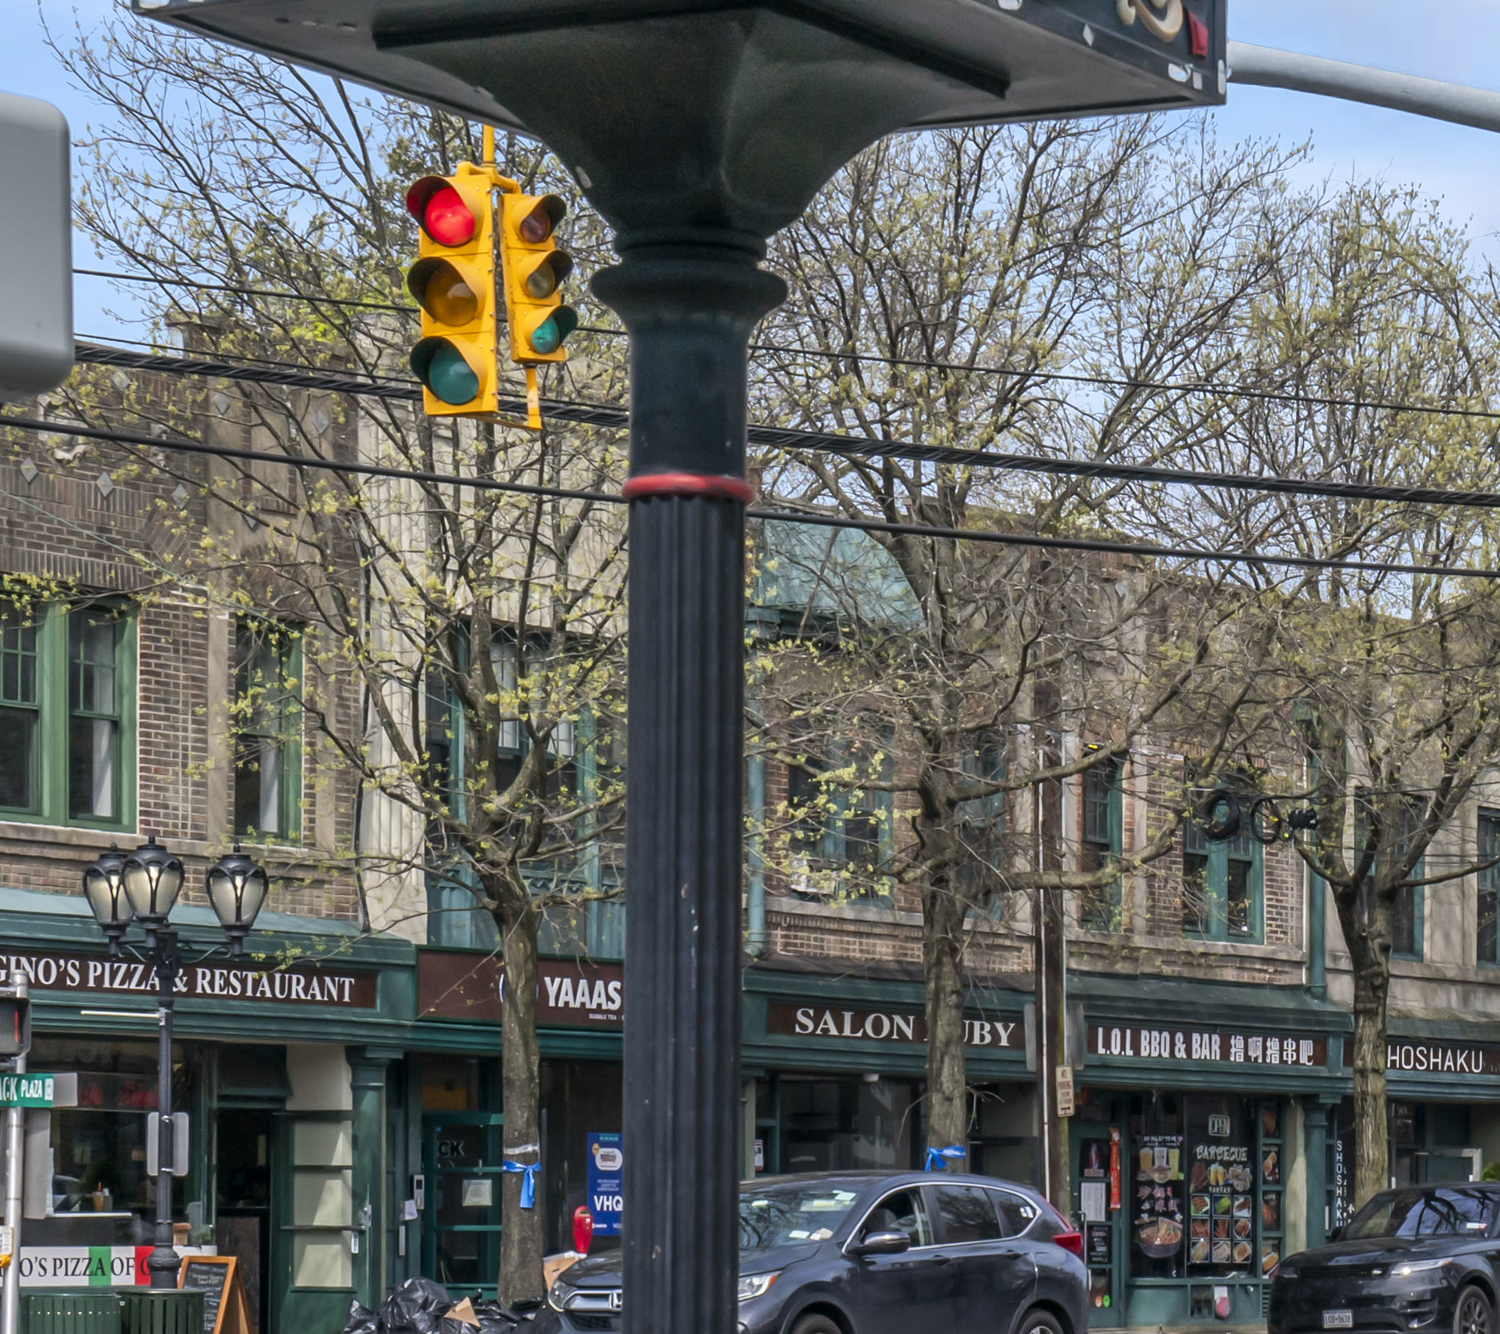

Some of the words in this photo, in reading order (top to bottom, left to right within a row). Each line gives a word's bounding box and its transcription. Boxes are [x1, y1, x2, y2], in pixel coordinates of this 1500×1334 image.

[87, 960, 160, 992] PIZZA
[172, 966, 189, 993] &
[195, 967, 355, 1003] RESTAURANT
[543, 976, 622, 1011] YAAAS
[795, 1007, 915, 1041] SALON
[1097, 1027, 1134, 1056] L.O.L
[1140, 1029, 1170, 1059] BBQ
[1174, 1032, 1187, 1059] &
[1191, 1033, 1221, 1061] BAR
[1387, 1044, 1484, 1074] HOSHAKU
[20, 1079, 43, 1098] PLAZA
[1196, 1145, 1249, 1162] BARBECUE
[52, 1257, 107, 1277] PIZZA
[110, 1257, 136, 1277] OF
